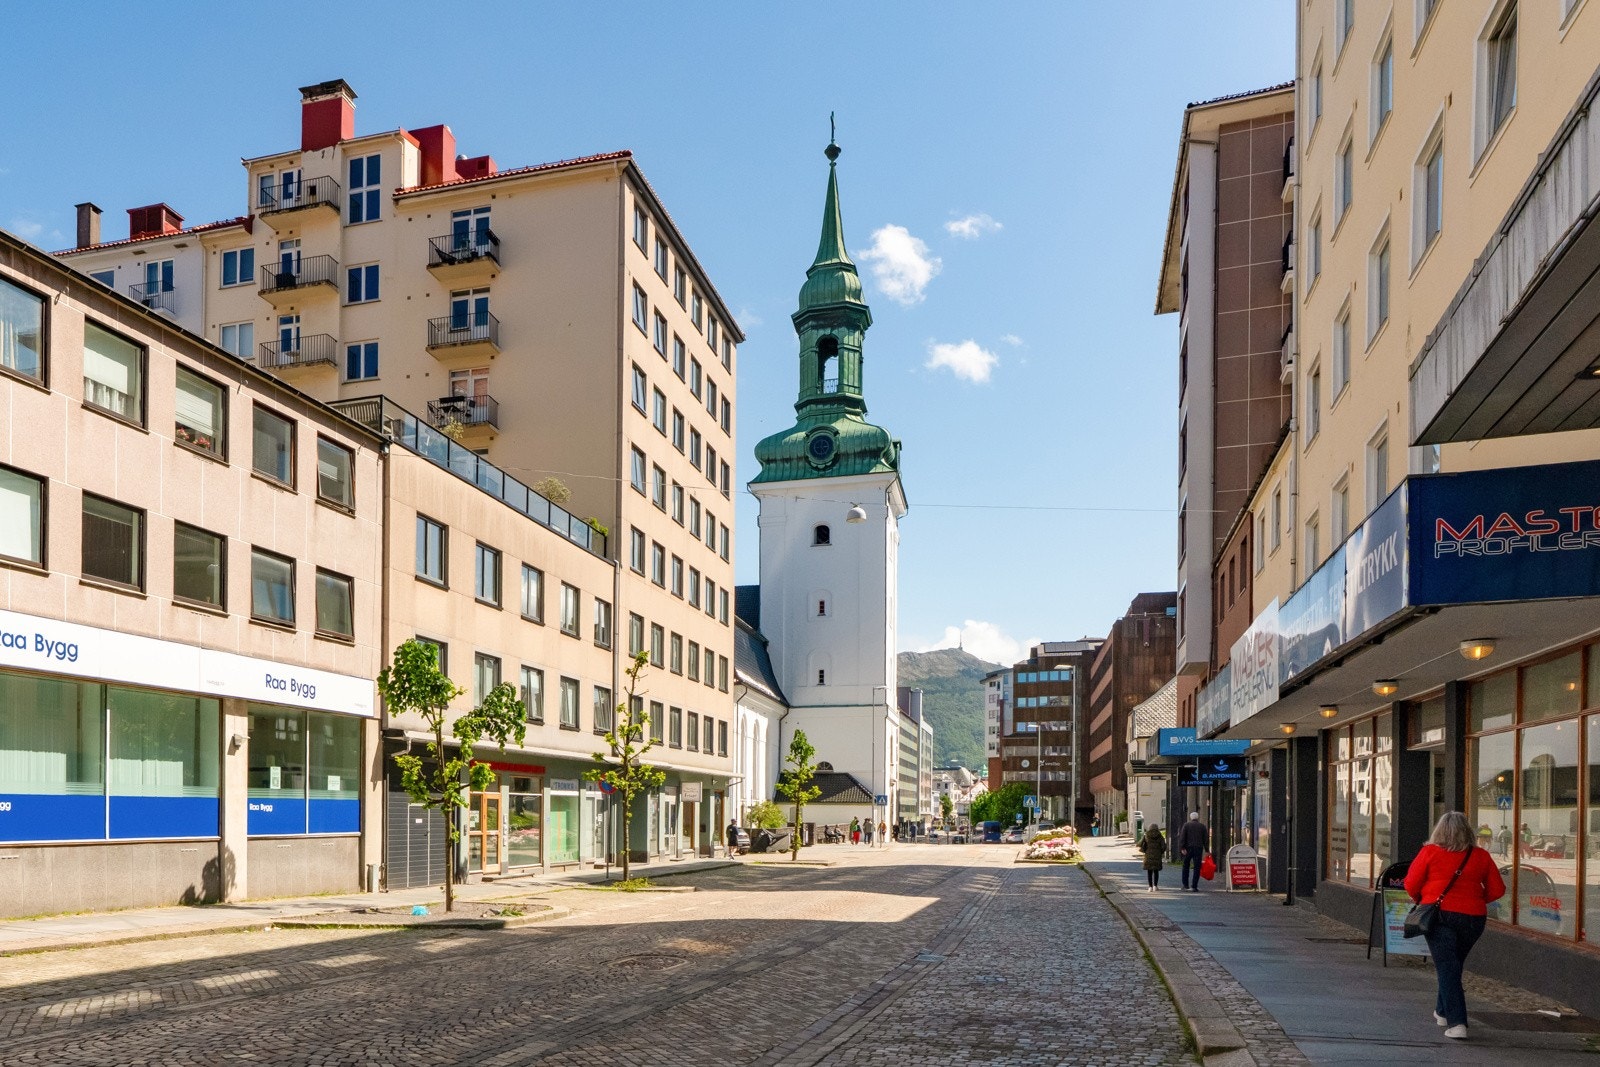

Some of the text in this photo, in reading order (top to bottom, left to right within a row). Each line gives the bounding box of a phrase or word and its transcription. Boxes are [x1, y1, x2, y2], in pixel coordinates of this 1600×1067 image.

[1435, 506, 1600, 542] MAST
[0, 630, 78, 662] aa Bygg
[265, 674, 316, 699] Raa Bygg
[249, 803, 273, 812] Raa Bygg
[1530, 895, 1562, 910] MASTER
